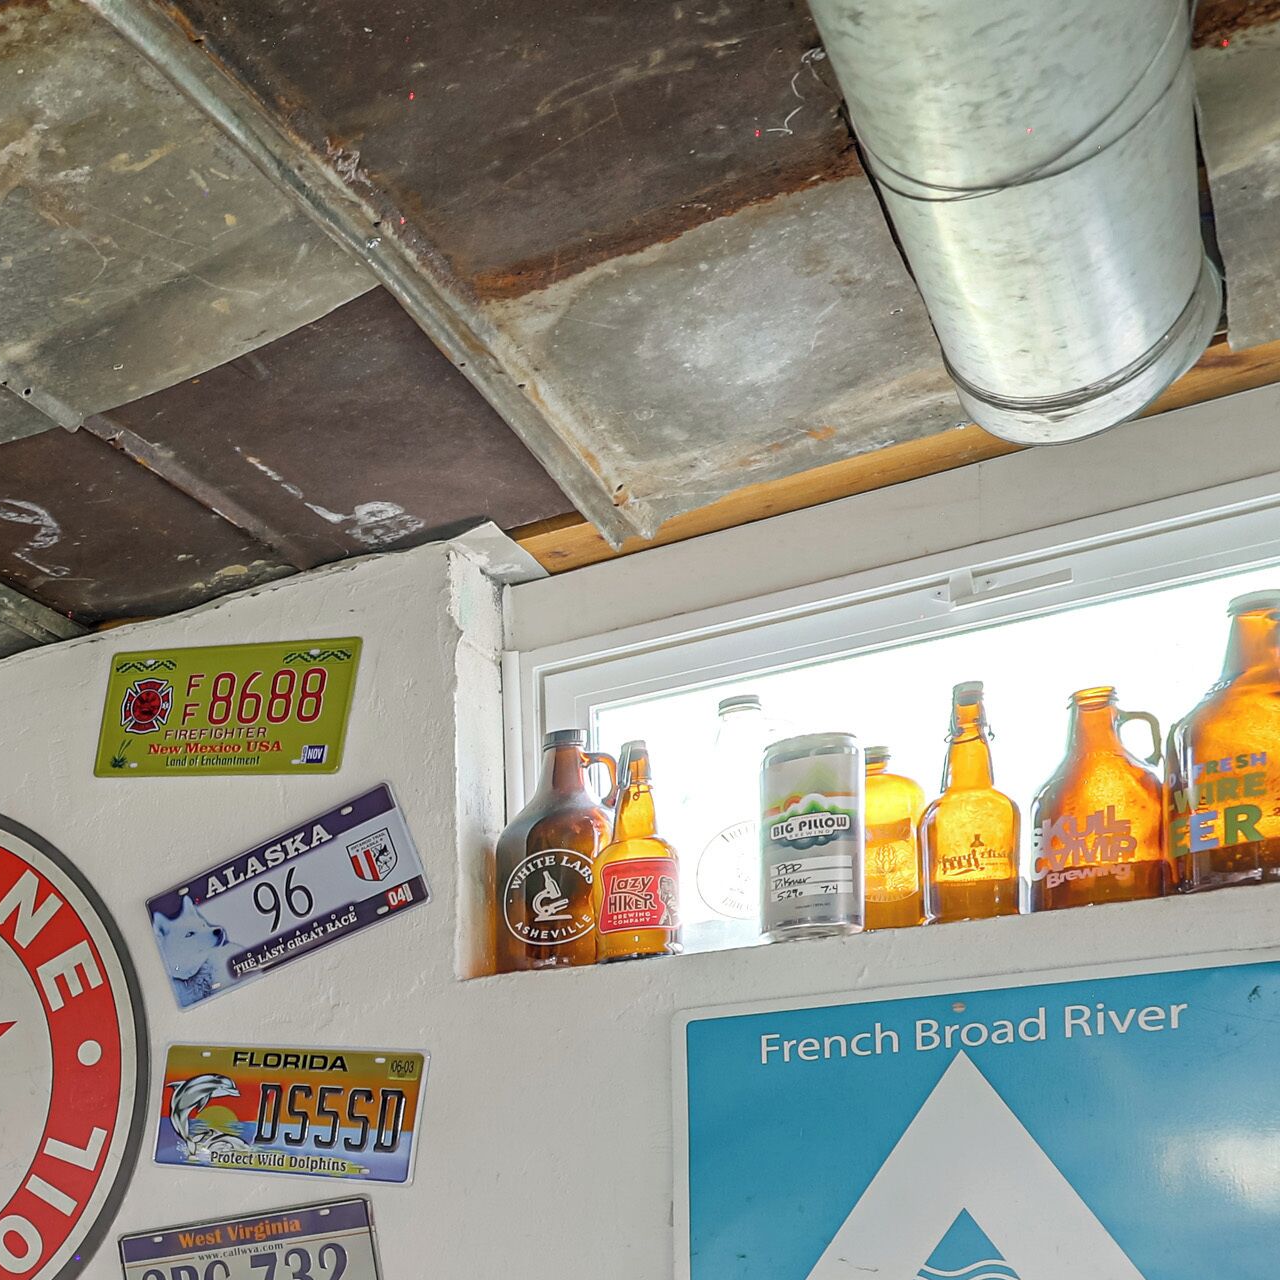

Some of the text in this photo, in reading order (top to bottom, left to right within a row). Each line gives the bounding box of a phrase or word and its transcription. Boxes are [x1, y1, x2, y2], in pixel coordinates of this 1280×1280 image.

[208, 666, 329, 726] 8688
[164, 726, 268, 741] FIREFIGHTER
[147, 740, 283, 756] New Mexico USA
[165, 754, 261, 767] Land Enchantment
[307, 746, 324, 761] NOV
[1192, 751, 1268, 779] FRESH
[773, 823, 794, 838] BIG
[798, 816, 847, 832] PILLOW
[1168, 803, 1265, 860] EER
[206, 823, 333, 899] ALASKA
[510, 855, 556, 890] WHITE
[611, 875, 655, 895] Lazy
[1046, 864, 1132, 889] Brewing
[252, 865, 315, 934] 96
[608, 893, 657, 915] HIKER
[515, 913, 593, 939] ASHEVILLE
[613, 911, 652, 921] BREWING
[233, 911, 358, 975] THE LAST GREAT RACE
[759, 1001, 1189, 1065] French Broad River
[232, 1051, 349, 1073] FLORIDA
[210, 1150, 347, 1173] Protect Wild Dolphins
[178, 1216, 302, 1250] West Virginia
